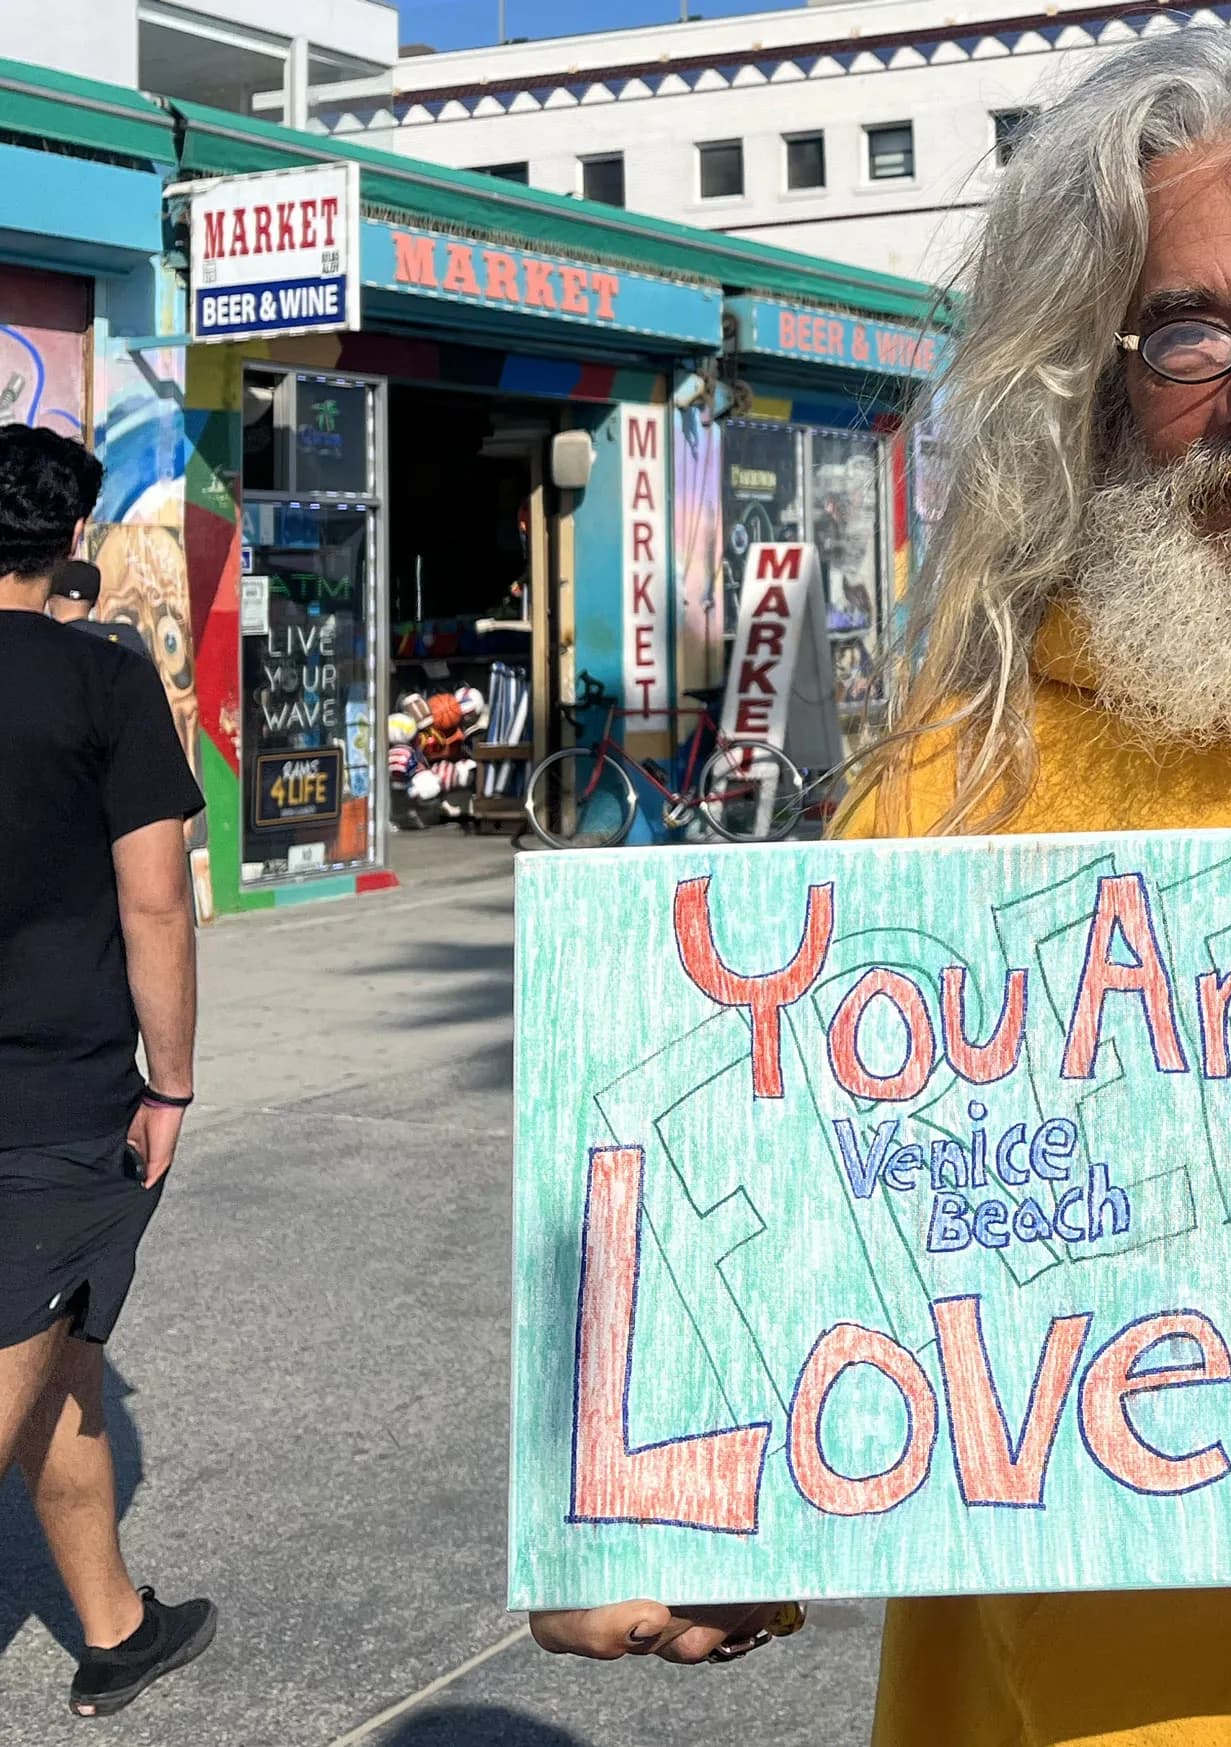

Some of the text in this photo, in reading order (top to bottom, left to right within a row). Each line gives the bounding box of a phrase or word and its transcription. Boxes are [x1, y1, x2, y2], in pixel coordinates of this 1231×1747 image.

[204, 196, 338, 260] MARKET
[203, 283, 339, 327] BEER & WINE
[392, 231, 620, 320] MARKET
[779, 311, 936, 372] BEER & WINE
[268, 573, 349, 598] ATM
[628, 417, 658, 719] MARKET
[268, 623, 335, 657] LIVE
[264, 665, 337, 692] YOUR
[262, 698, 337, 731] WAVE
[673, 873, 1028, 1102] You
[832, 1100, 1079, 1199] Venice
[926, 1163, 1131, 1253] Beach
